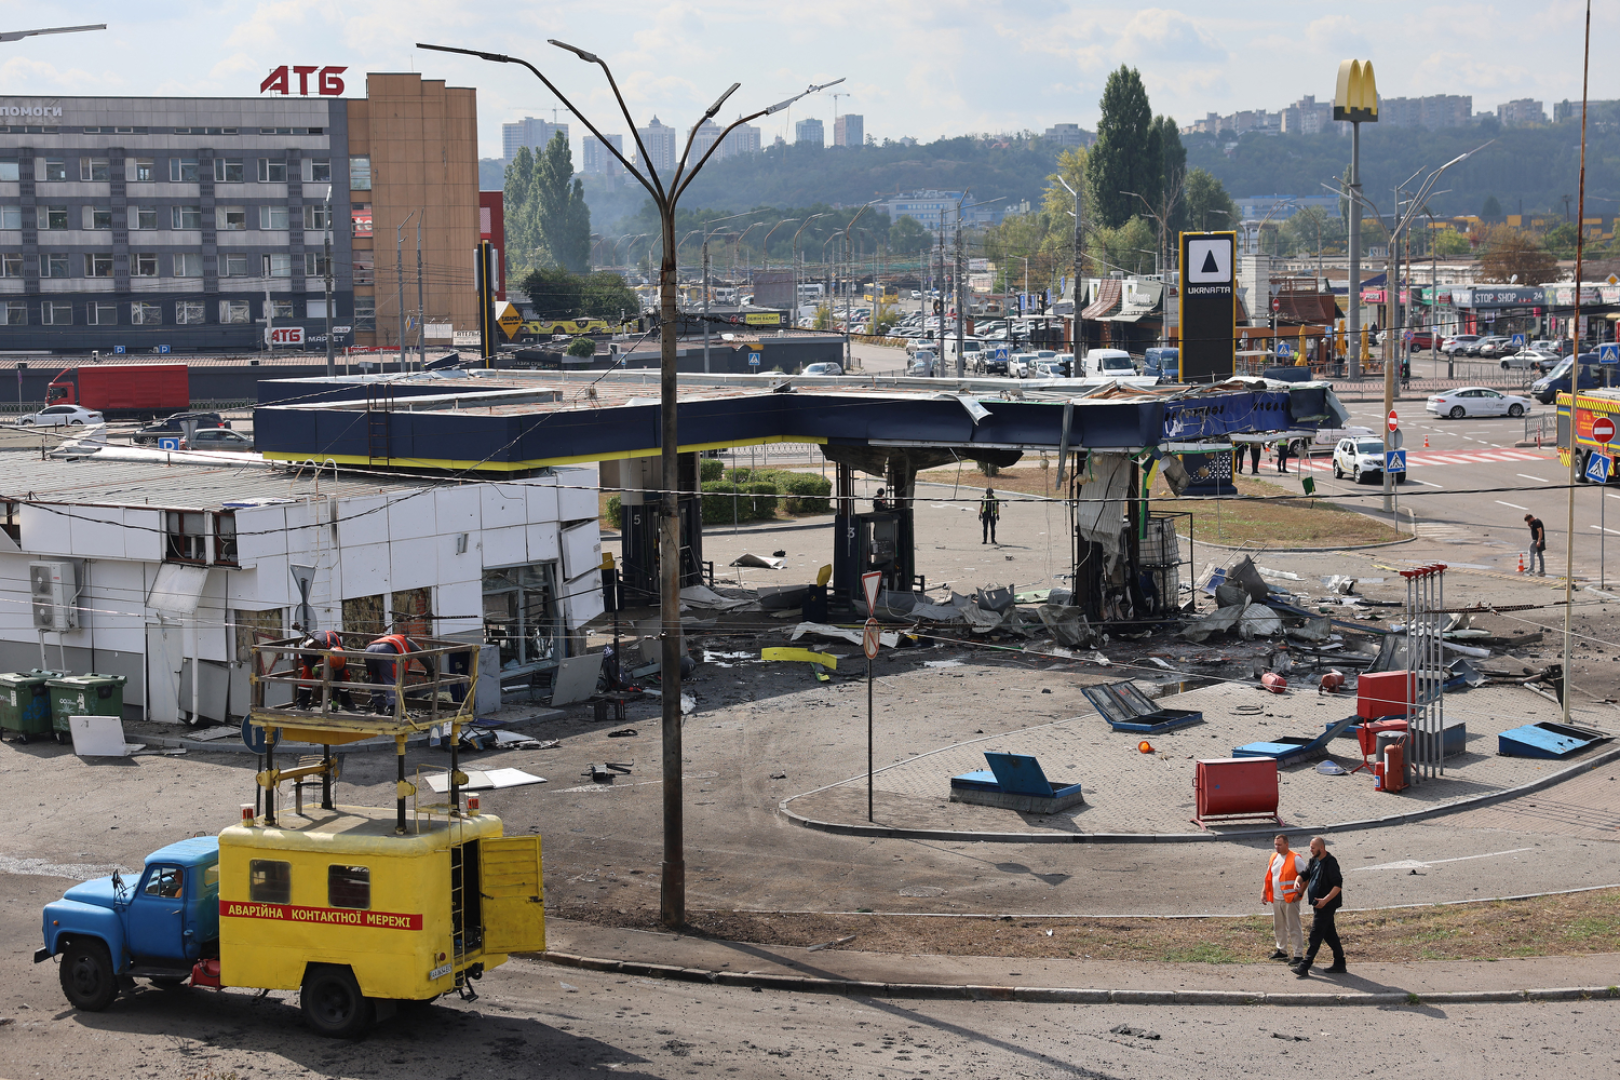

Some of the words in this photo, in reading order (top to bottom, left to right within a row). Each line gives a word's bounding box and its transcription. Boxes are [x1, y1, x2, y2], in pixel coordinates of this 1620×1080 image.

[260, 65, 348, 95] АТБ
[1187, 286, 1230, 294] UKRNAFTA
[1533, 291, 1543, 300] 24
[1475, 293, 1494, 304] STOP
[1497, 292, 1516, 303] SHOP
[633, 514, 641, 525] 5
[847, 527, 855, 539] 3
[228, 903, 284, 919] АВАРІЙНА
[291, 908, 362, 924] КОНТАКТНОЇ
[366, 912, 411, 928] МЕРЕЖІ
